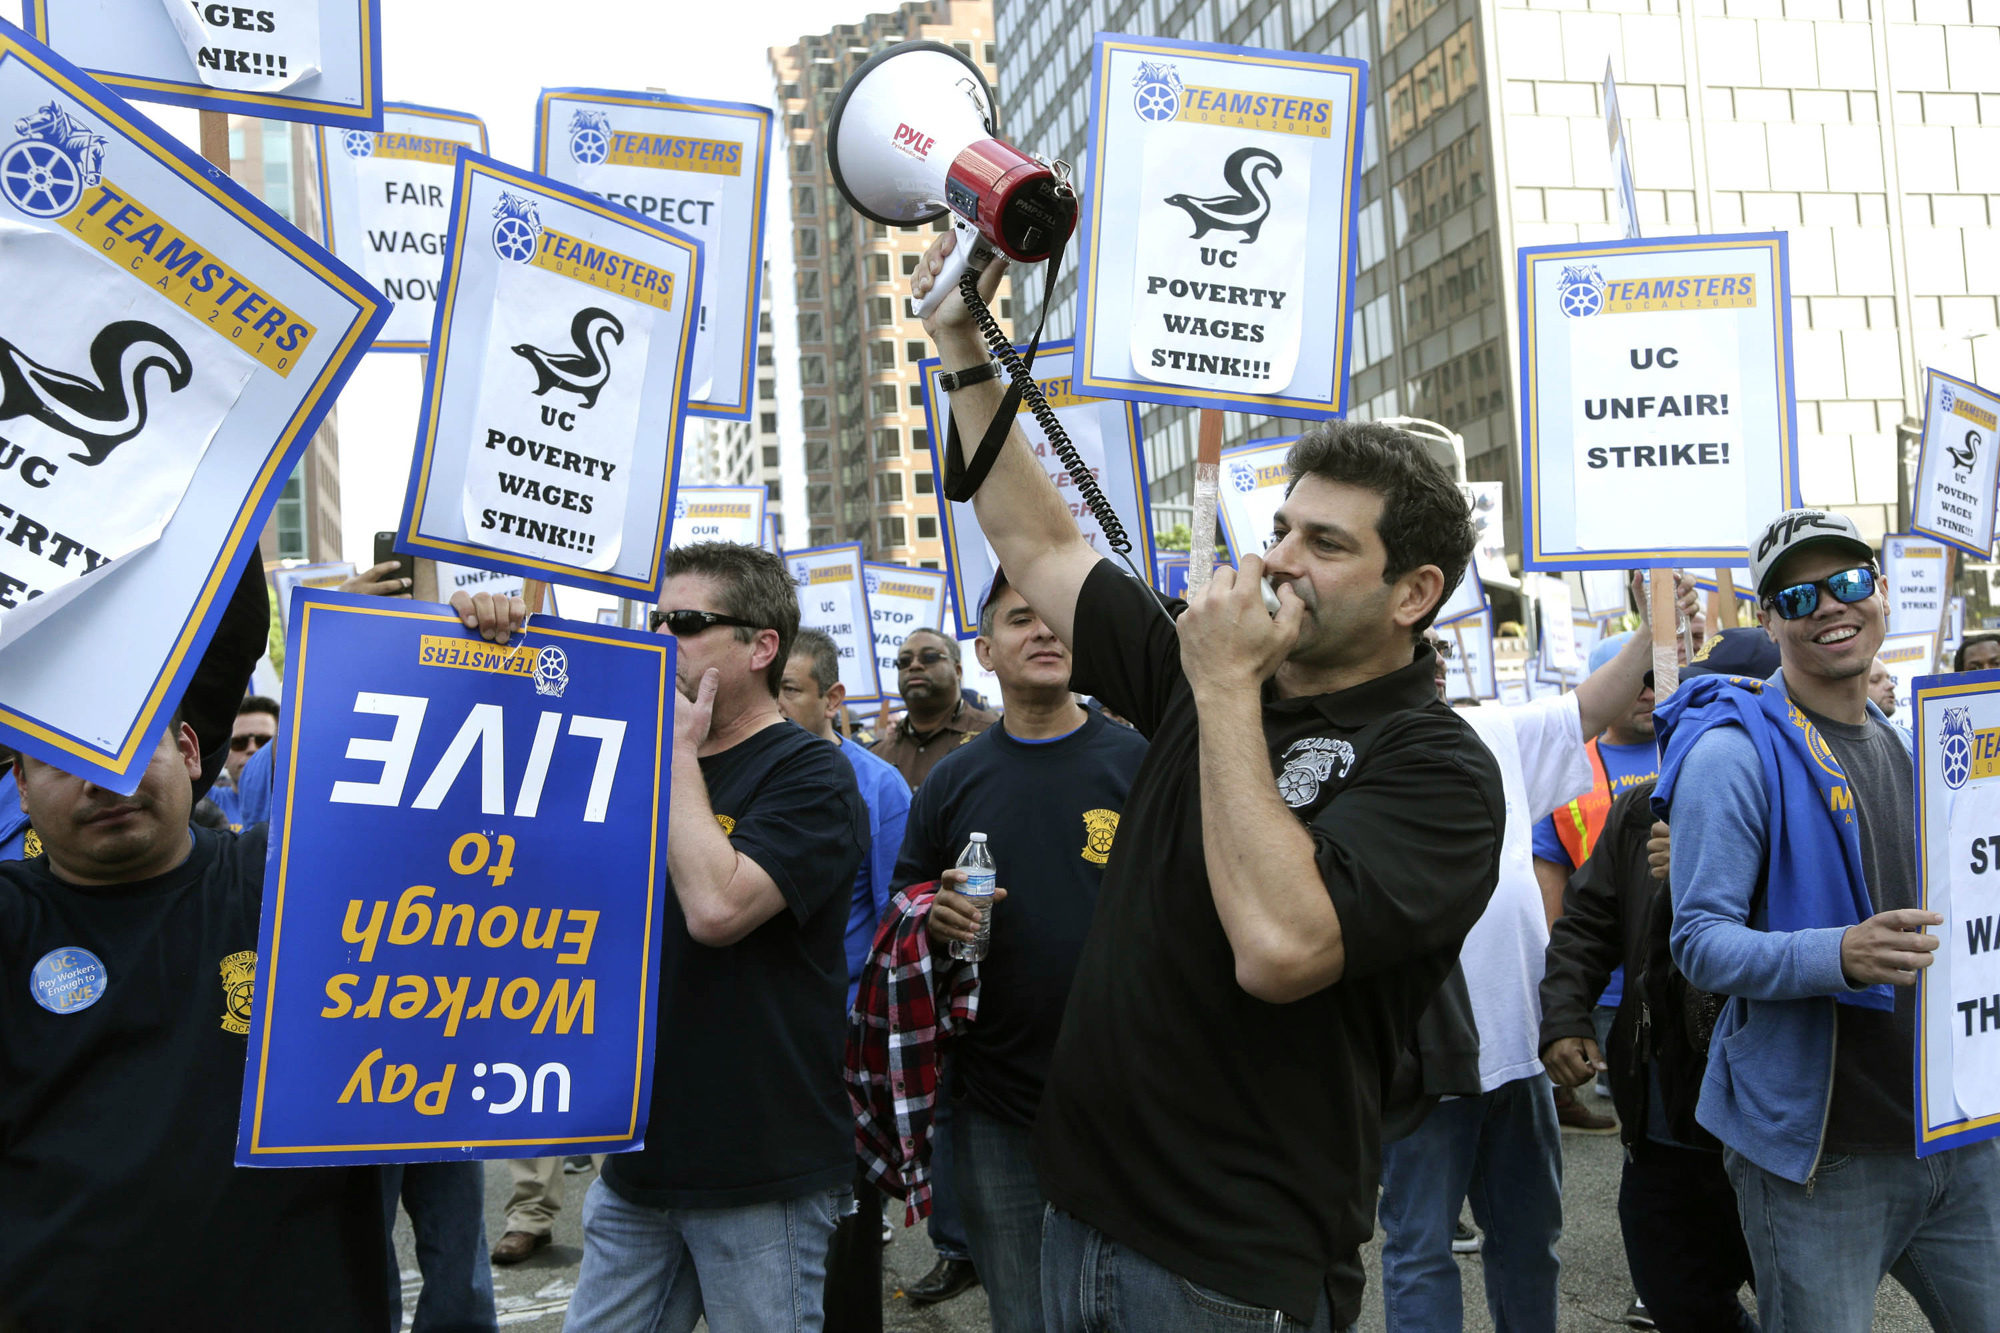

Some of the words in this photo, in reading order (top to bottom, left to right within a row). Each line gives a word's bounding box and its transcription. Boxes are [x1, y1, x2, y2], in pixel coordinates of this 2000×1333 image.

[191, 1, 275, 33] GES
[198, 46, 287, 78] NK!!!
[1184, 88, 1330, 124] TEAMSTERS
[377, 134, 471, 157] TEAMSTE
[614, 133, 740, 164] TEAMSTERS
[385, 182, 444, 208] FAIR
[584, 192, 714, 226] SPECT
[86, 186, 309, 352] TEAMSTERS
[541, 231, 672, 295] TEAMSTERS
[1200, 247, 1237, 268] UC
[1147, 276, 1286, 309] POVERTY
[1608, 277, 1752, 301] TEAMSTERS
[1163, 313, 1264, 343] WAGES
[1151, 348, 1271, 379] STINK!!!
[1630, 347, 1679, 370] UC
[541, 405, 576, 432] UC
[1585, 394, 1729, 420] UNFAIR!
[1954, 399, 1998, 426] TEAMSTERS
[485, 428, 617, 482] POVERTY
[1587, 443, 1730, 469] STRIKE!
[1955, 473, 1966, 484] UC
[498, 471, 594, 515] WAGES
[1937, 483, 1978, 506] POVERTY
[689, 504, 751, 514] TEAMSTERS
[1941, 501, 1972, 520] WAGES
[481, 508, 596, 554] STINK!!!
[691, 526, 719, 535] OUR
[1936, 516, 1974, 538] STINK!!!
[455, 571, 511, 587] UNFA
[809, 564, 853, 580] TEAMSTERS
[1911, 570, 1925, 578] UC
[879, 581, 935, 596] TEAMSTERS
[1900, 586, 1937, 594] UNFAIR!
[821, 601, 835, 613] UC
[872, 609, 914, 624] STOP
[1901, 602, 1938, 610] STRIKE!
[814, 623, 852, 635] NFAIR!
[422, 646, 534, 674] TEAMSTERS
[1877, 646, 1924, 661] AMSTERS
[329, 691, 628, 823] LIVE
[448, 832, 516, 887] to
[1083, 852, 1105, 863] LOCAL
[341, 885, 600, 965] Enough
[49, 955, 78, 973] UC:
[221, 951, 258, 967] TEAMSTE
[38, 978, 56, 990] Pay
[57, 964, 96, 982] Workers
[47, 978, 84, 997] Enough
[85, 974, 96, 983] to
[60, 985, 94, 1009] LIVE
[320, 973, 596, 1037] Workers
[225, 1022, 250, 1033] LOCA
[336, 1047, 458, 1116] Pay
[471, 1062, 571, 1115] UC:
